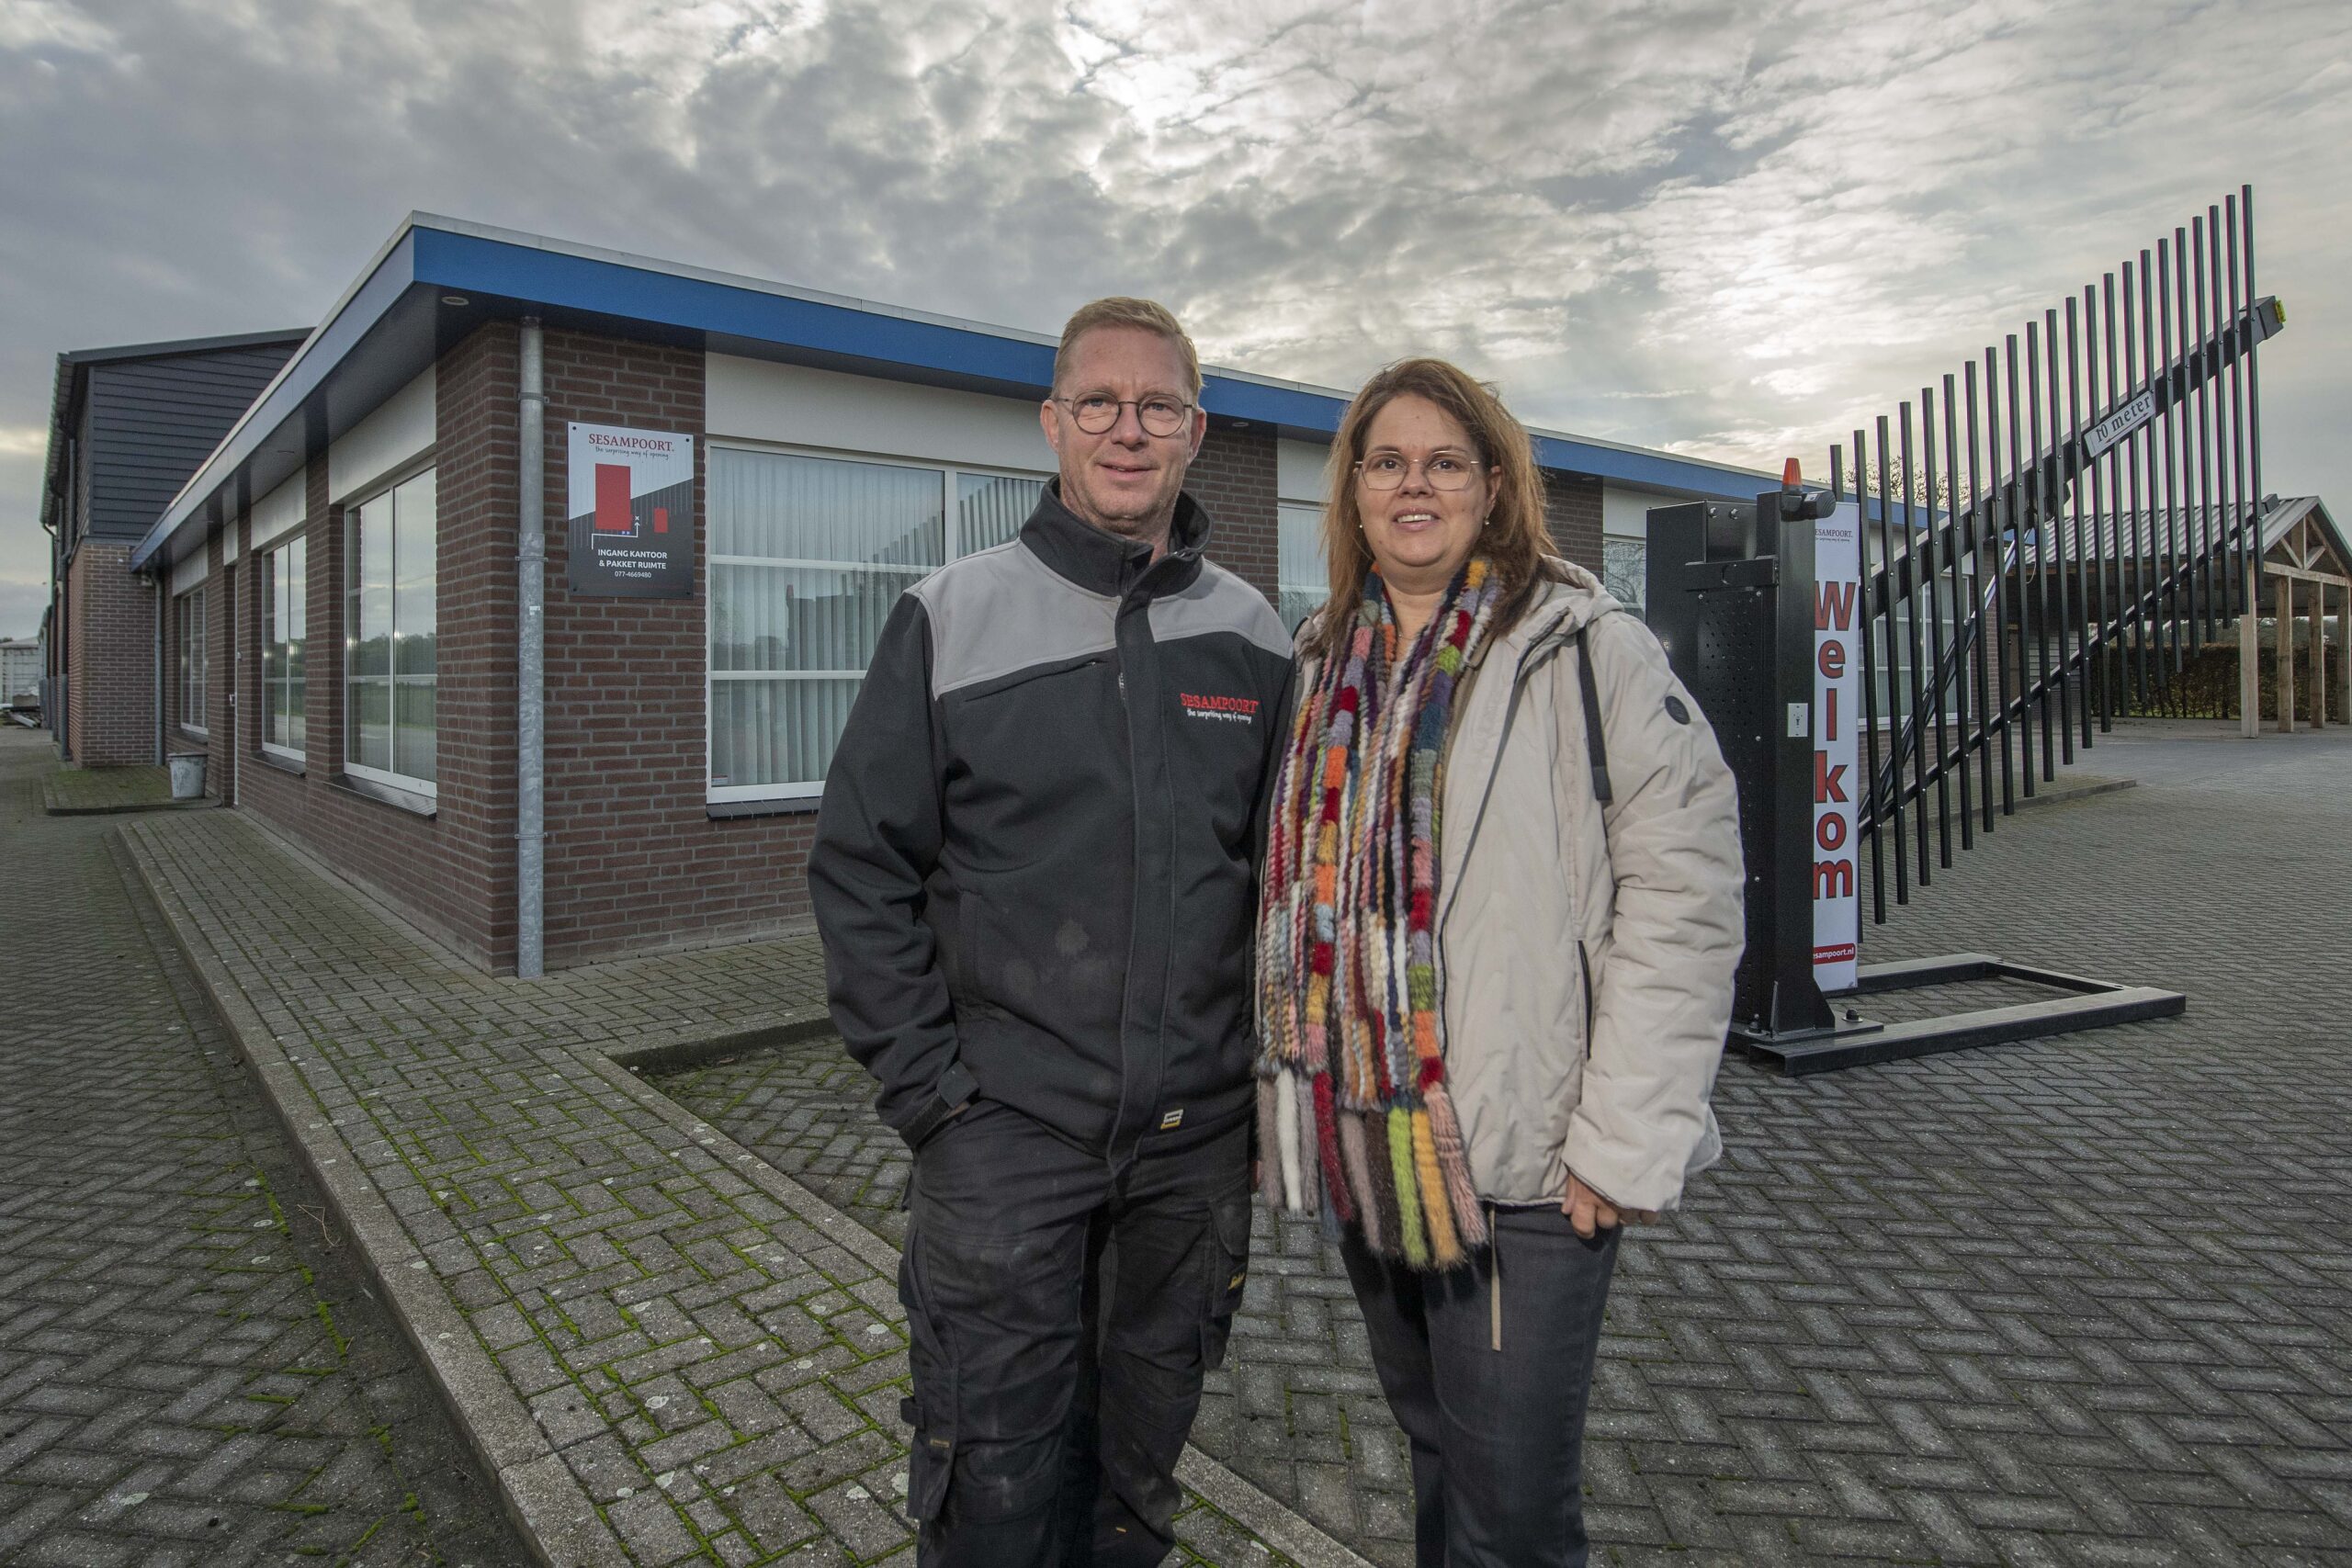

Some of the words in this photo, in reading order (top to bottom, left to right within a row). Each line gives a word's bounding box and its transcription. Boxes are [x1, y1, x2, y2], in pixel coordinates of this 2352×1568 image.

[2096, 423, 2109, 443] 10
[2110, 396, 2151, 432] meter
[597, 548, 628, 558] INGANG
[629, 550, 668, 559] KANTOOR
[606, 559, 637, 569] PAKKET
[638, 561, 667, 570] RUIMTE
[1180, 692, 1260, 714] SESAMPOORT
